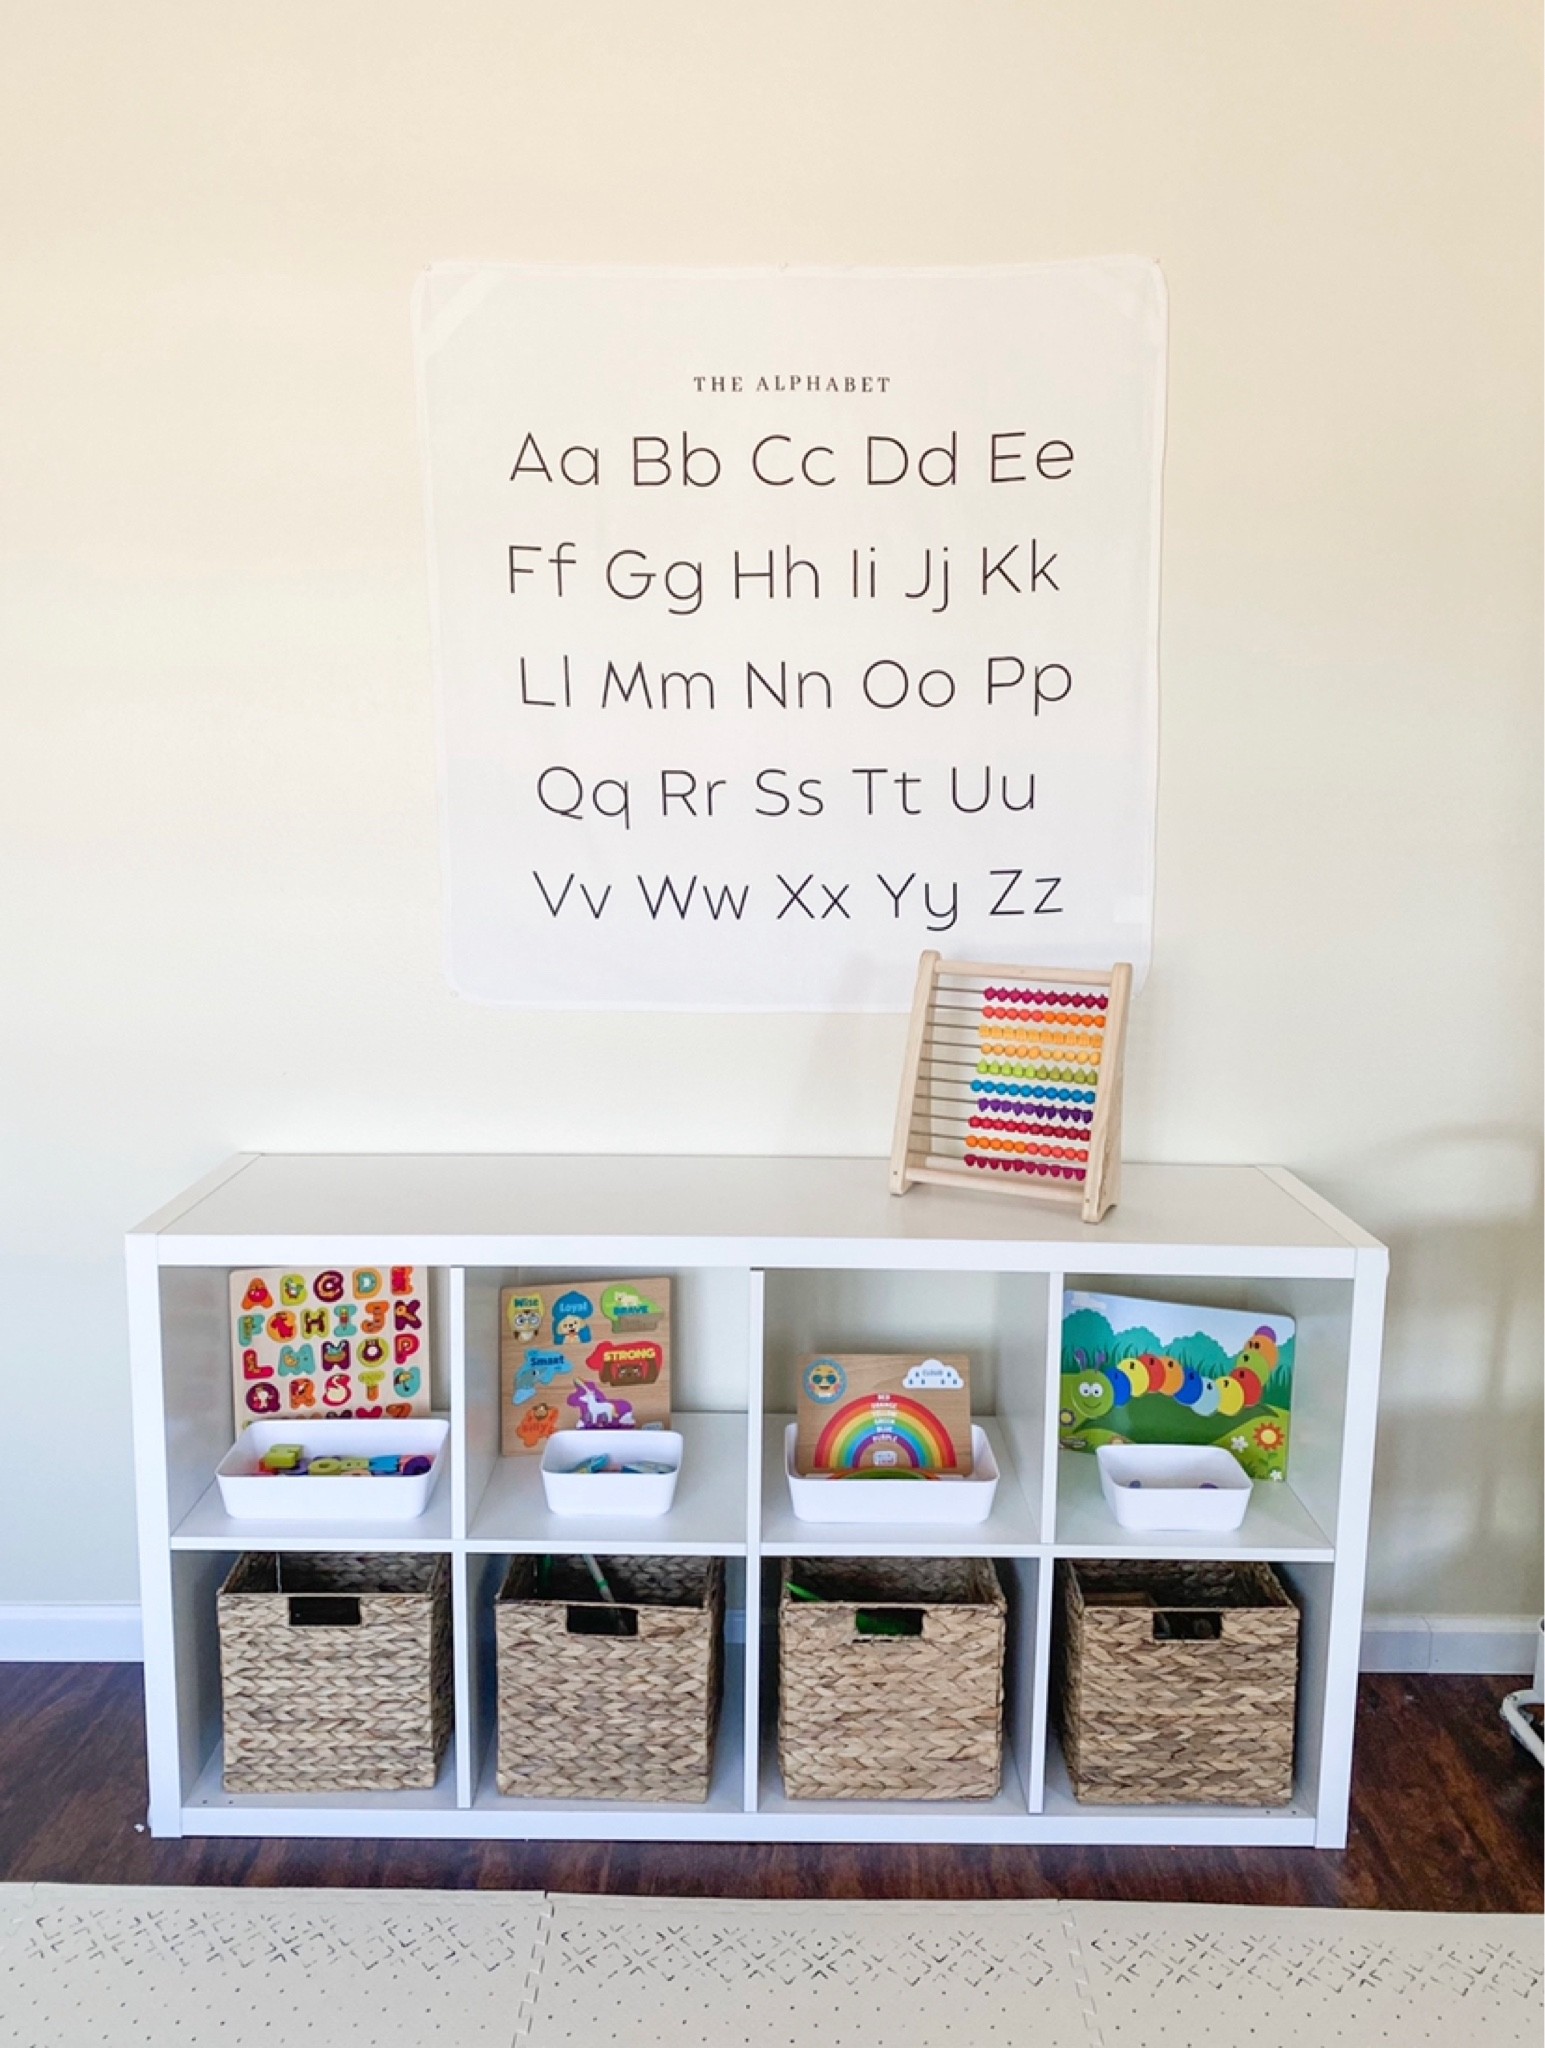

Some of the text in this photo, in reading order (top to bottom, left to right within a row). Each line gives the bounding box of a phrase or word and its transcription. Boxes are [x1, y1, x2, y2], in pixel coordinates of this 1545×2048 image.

[693, 374, 891, 393] THE ALPHABET
[509, 431, 1074, 487] Aa Bb Cc Dd Ee
[508, 538, 1060, 615] Ff Gg Hh Ii Jj Kk
[520, 655, 1072, 717] Ll Mm Nn Oo Pp
[537, 765, 1035, 830] Qq Rr Ss Tt Uu
[533, 869, 1064, 931] Vv Ww Xx Yy Zz
[241, 1277, 274, 1310] A
[313, 1270, 344, 1302] C
[352, 1267, 382, 1299] D
[361, 1301, 390, 1334] J
[394, 1300, 422, 1331] K
[242, 1349, 274, 1380] L
[394, 1333, 420, 1365] P
[603, 1347, 656, 1362] STRONG
[322, 1373, 351, 1407] S
[358, 1370, 386, 1401] T
